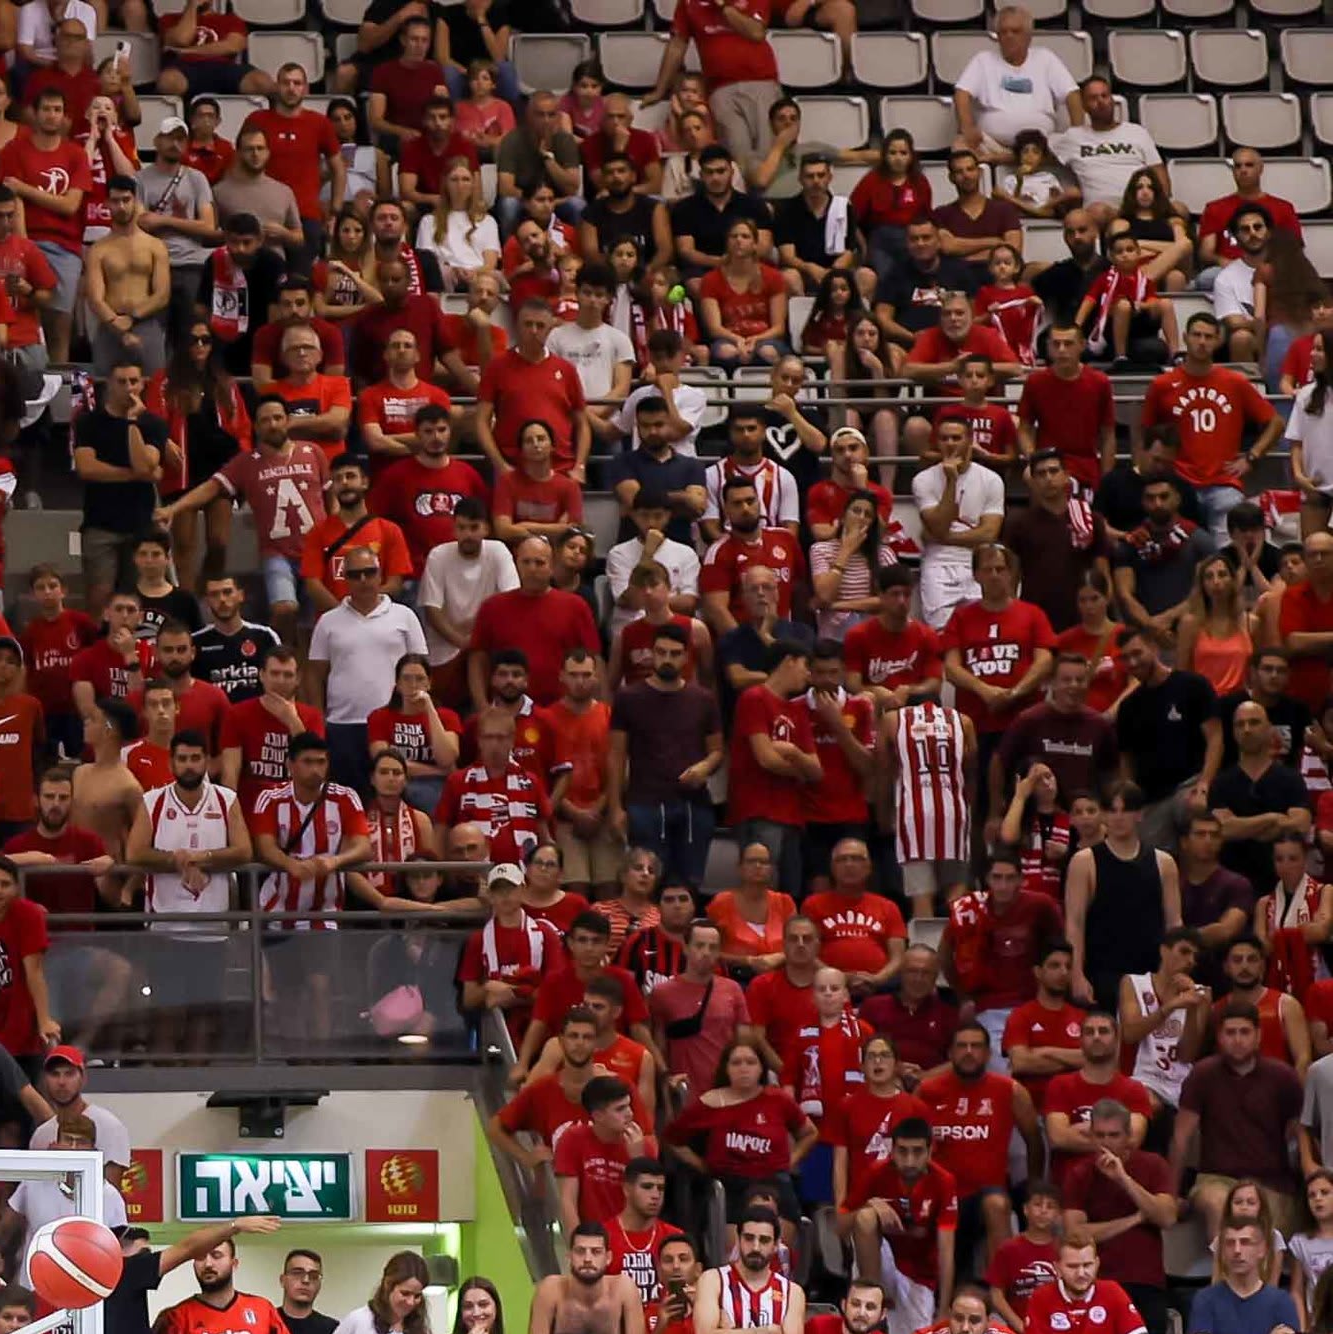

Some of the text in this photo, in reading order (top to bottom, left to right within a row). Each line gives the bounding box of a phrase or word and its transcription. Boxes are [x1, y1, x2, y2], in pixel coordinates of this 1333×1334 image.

[1172, 386, 1232, 417] RAPTORS
[1189, 407, 1216, 433] 10
[258, 463, 314, 481] ADMIRABLE
[269, 479, 316, 540] A
[989, 623, 999, 639] I
[971, 659, 1014, 678] YOU
[932, 1125, 989, 1141] EPSON
[725, 1132, 772, 1155] HAPOEL
[195, 1160, 337, 1213] יציאה
[387, 1204, 418, 1215] טוטו
[623, 1253, 653, 1270] אהבה
